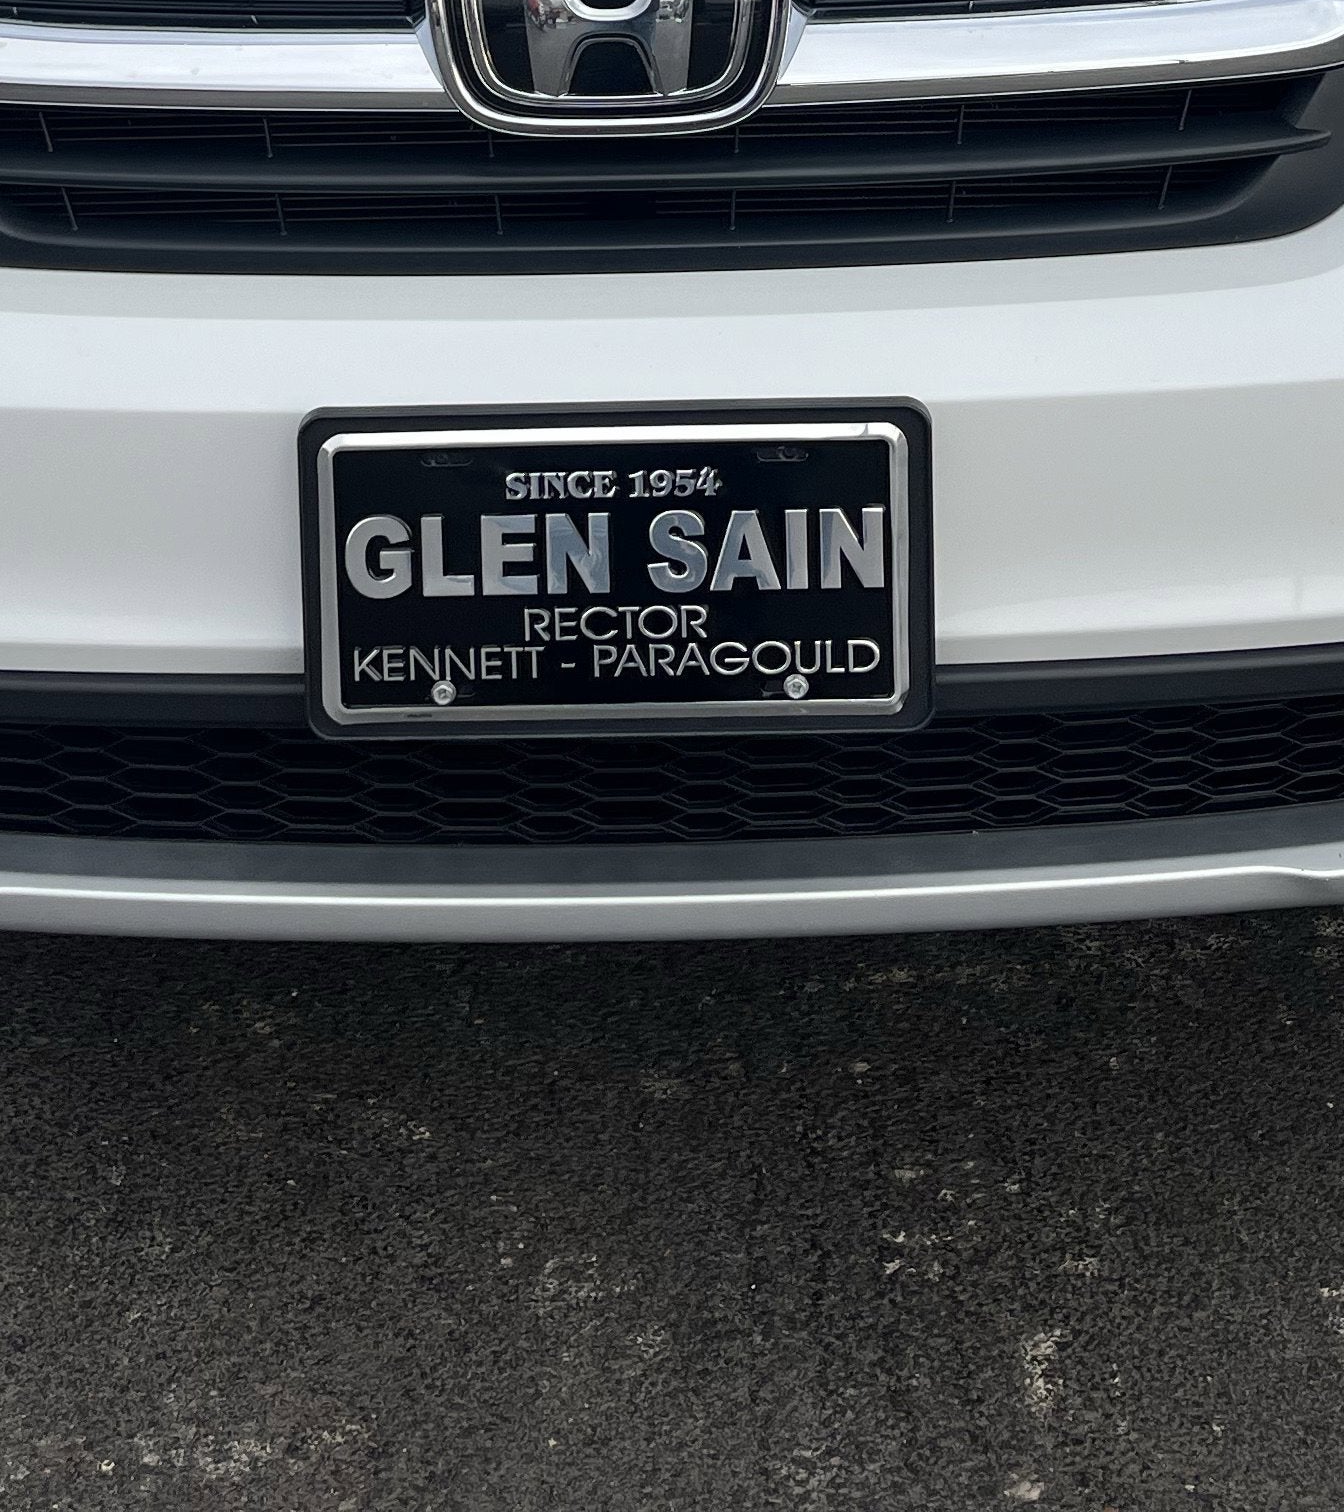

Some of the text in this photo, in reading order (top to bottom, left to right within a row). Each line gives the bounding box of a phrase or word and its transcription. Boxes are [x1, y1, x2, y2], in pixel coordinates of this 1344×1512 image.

[505, 467, 723, 501] SINCE 1954
[345, 507, 886, 600] GLEN SAIN
[523, 604, 709, 643] RECTOR
[354, 645, 545, 684] KENNETT
[593, 639, 881, 678] PARAGOULD
